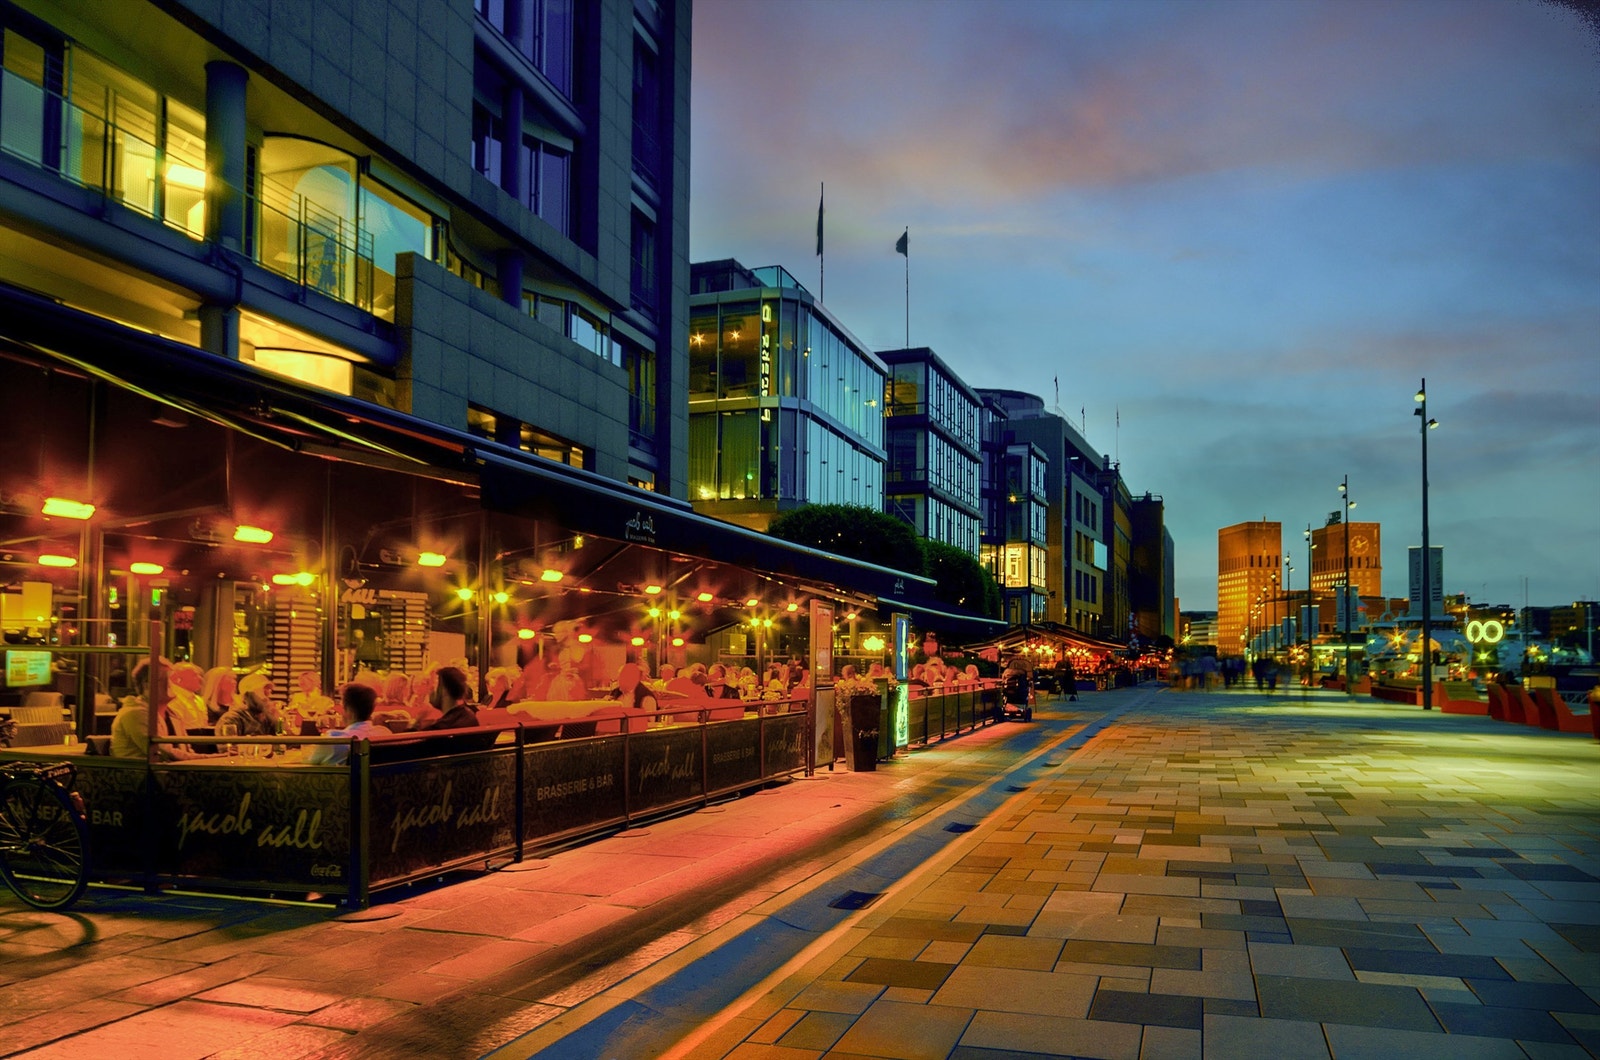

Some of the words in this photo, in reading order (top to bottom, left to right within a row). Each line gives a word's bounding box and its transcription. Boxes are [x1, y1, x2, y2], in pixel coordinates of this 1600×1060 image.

[536, 778, 587, 801] BRASSERIE
[588, 779, 595, 789] &
[596, 774, 614, 788] BAR
[639, 744, 670, 793] jacob
[671, 751, 695, 780] aall
[91, 810, 123, 827] BAR
[176, 791, 252, 851] jacob
[257, 809, 323, 850] aall
[390, 779, 454, 853] jacob
[456, 785, 501, 830] aall
